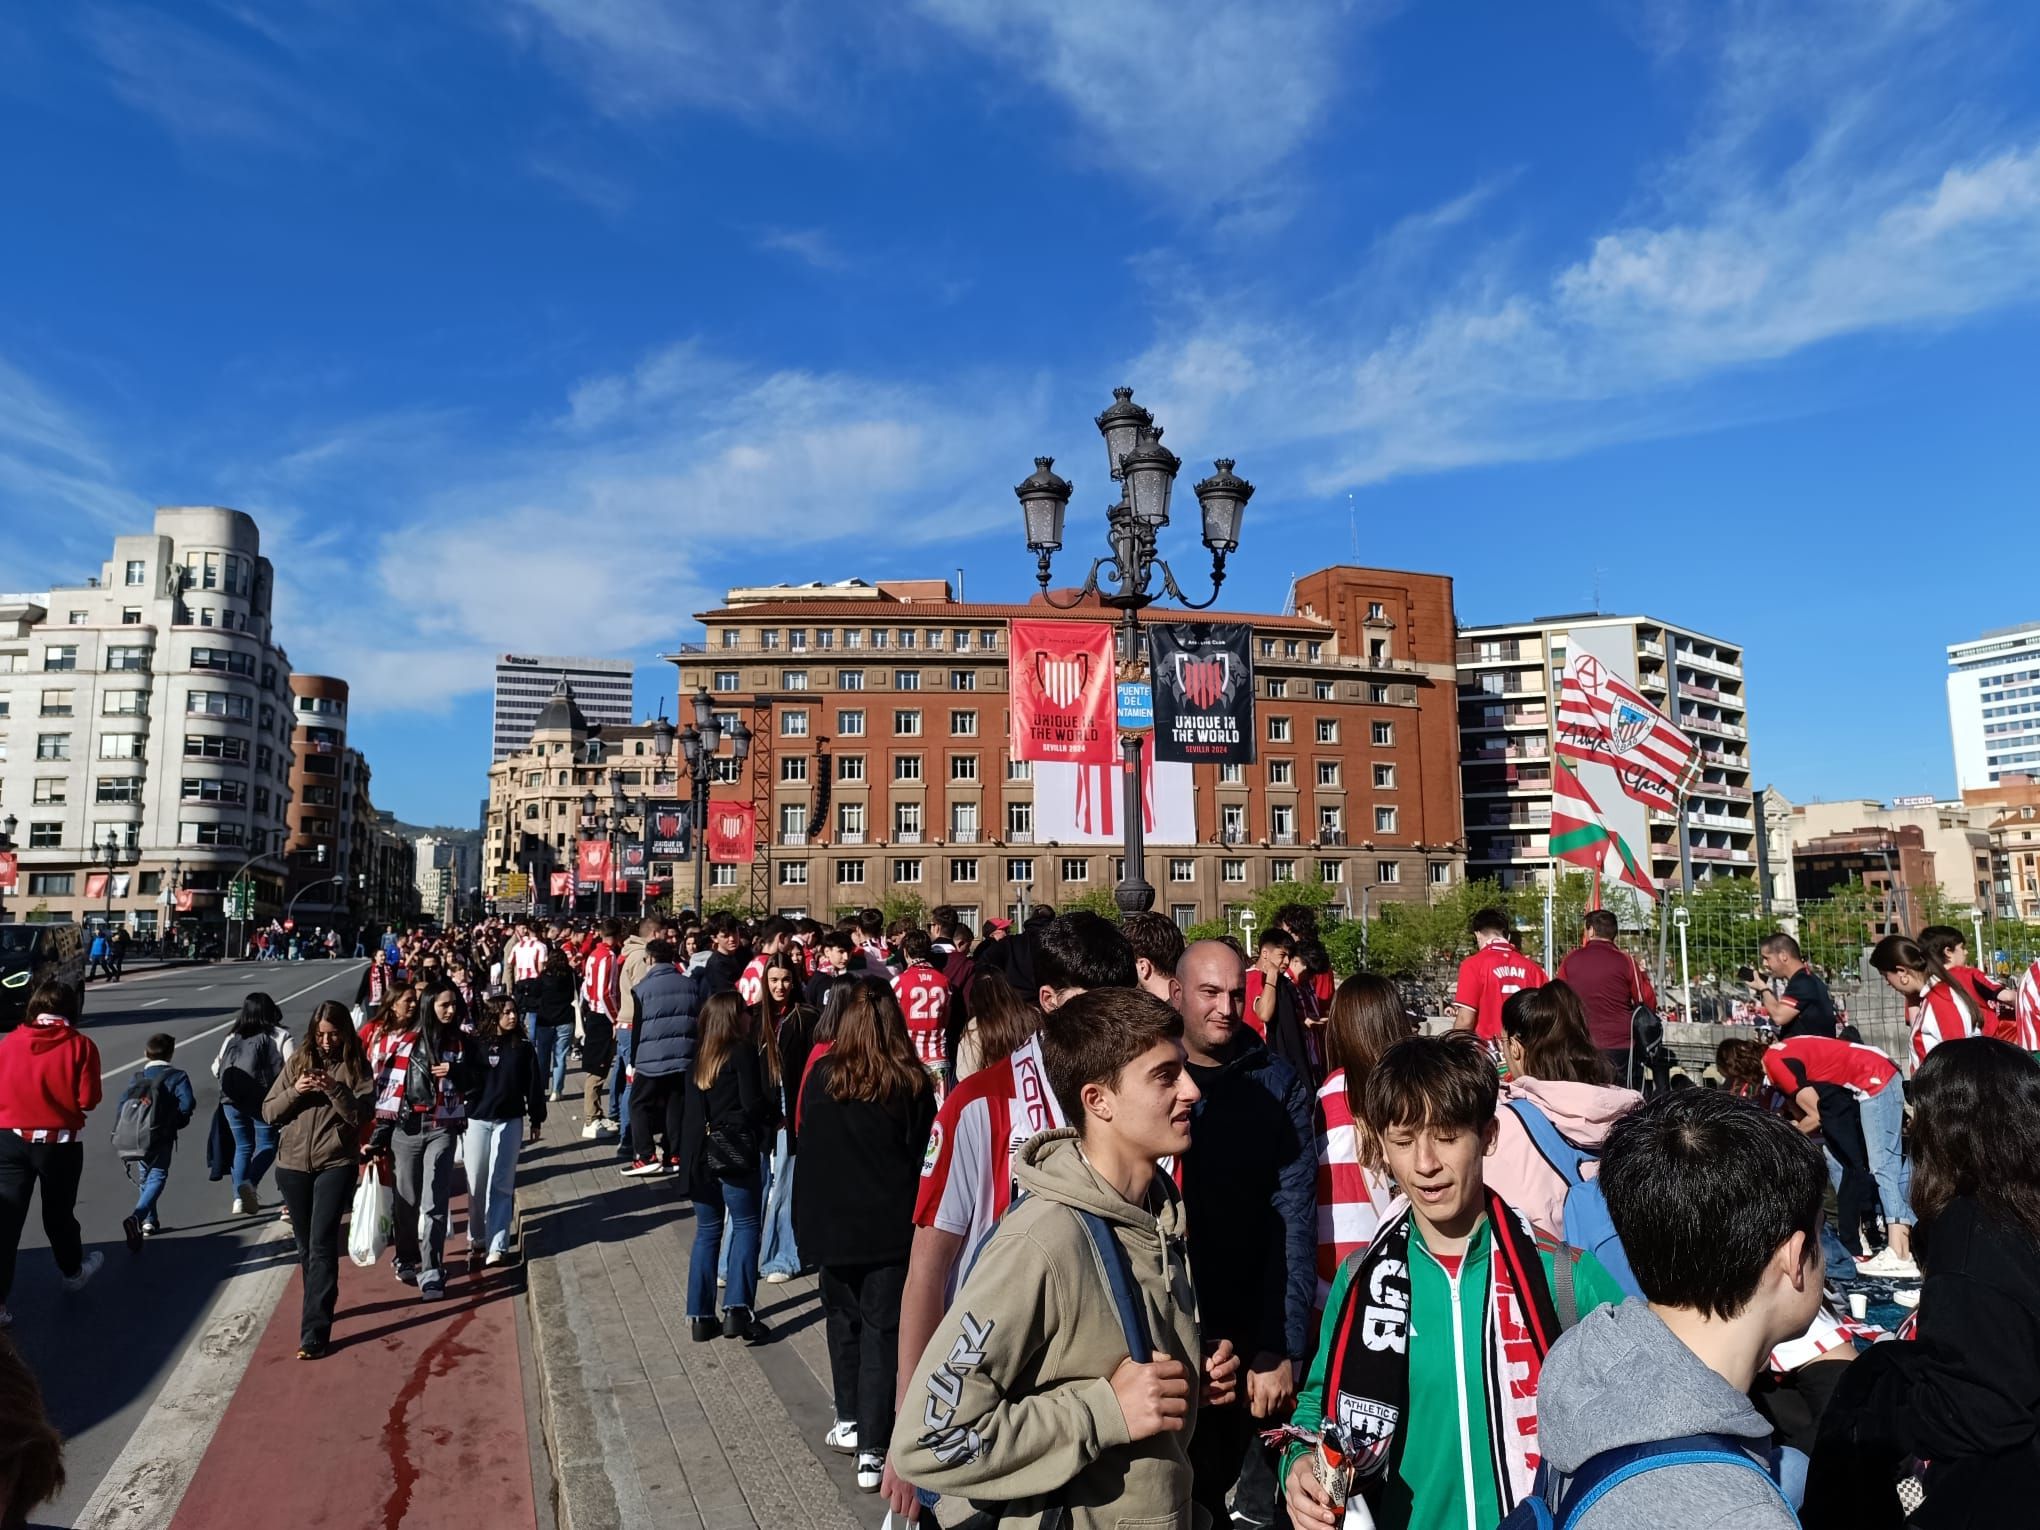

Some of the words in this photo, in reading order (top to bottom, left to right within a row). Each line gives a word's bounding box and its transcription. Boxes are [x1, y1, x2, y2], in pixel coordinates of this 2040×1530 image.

[1117, 686, 1151, 696] PUENTE
[1124, 696, 1143, 706] DEL
[1117, 707, 1153, 718] NTAMIEN
[1033, 714, 1078, 728] UNIQUE
[1083, 715, 1095, 728] IN
[1175, 715, 1221, 729] UNIQUE
[1224, 716, 1236, 730] IN
[1030, 727, 1052, 740] THE
[1055, 727, 1098, 742] WORLD
[1172, 729, 1194, 742] THE
[1196, 730, 1240, 743] WORLD
[1042, 743, 1068, 752] SEVILLA
[1069, 744, 1086, 753] 2024
[1185, 745, 1210, 753] SEVILLA
[1492, 965, 1526, 979] VIVIAN
[909, 986, 946, 1020] 22
[923, 1311, 995, 1431] CURL
[1343, 1399, 1391, 1419] ATHLETIC
